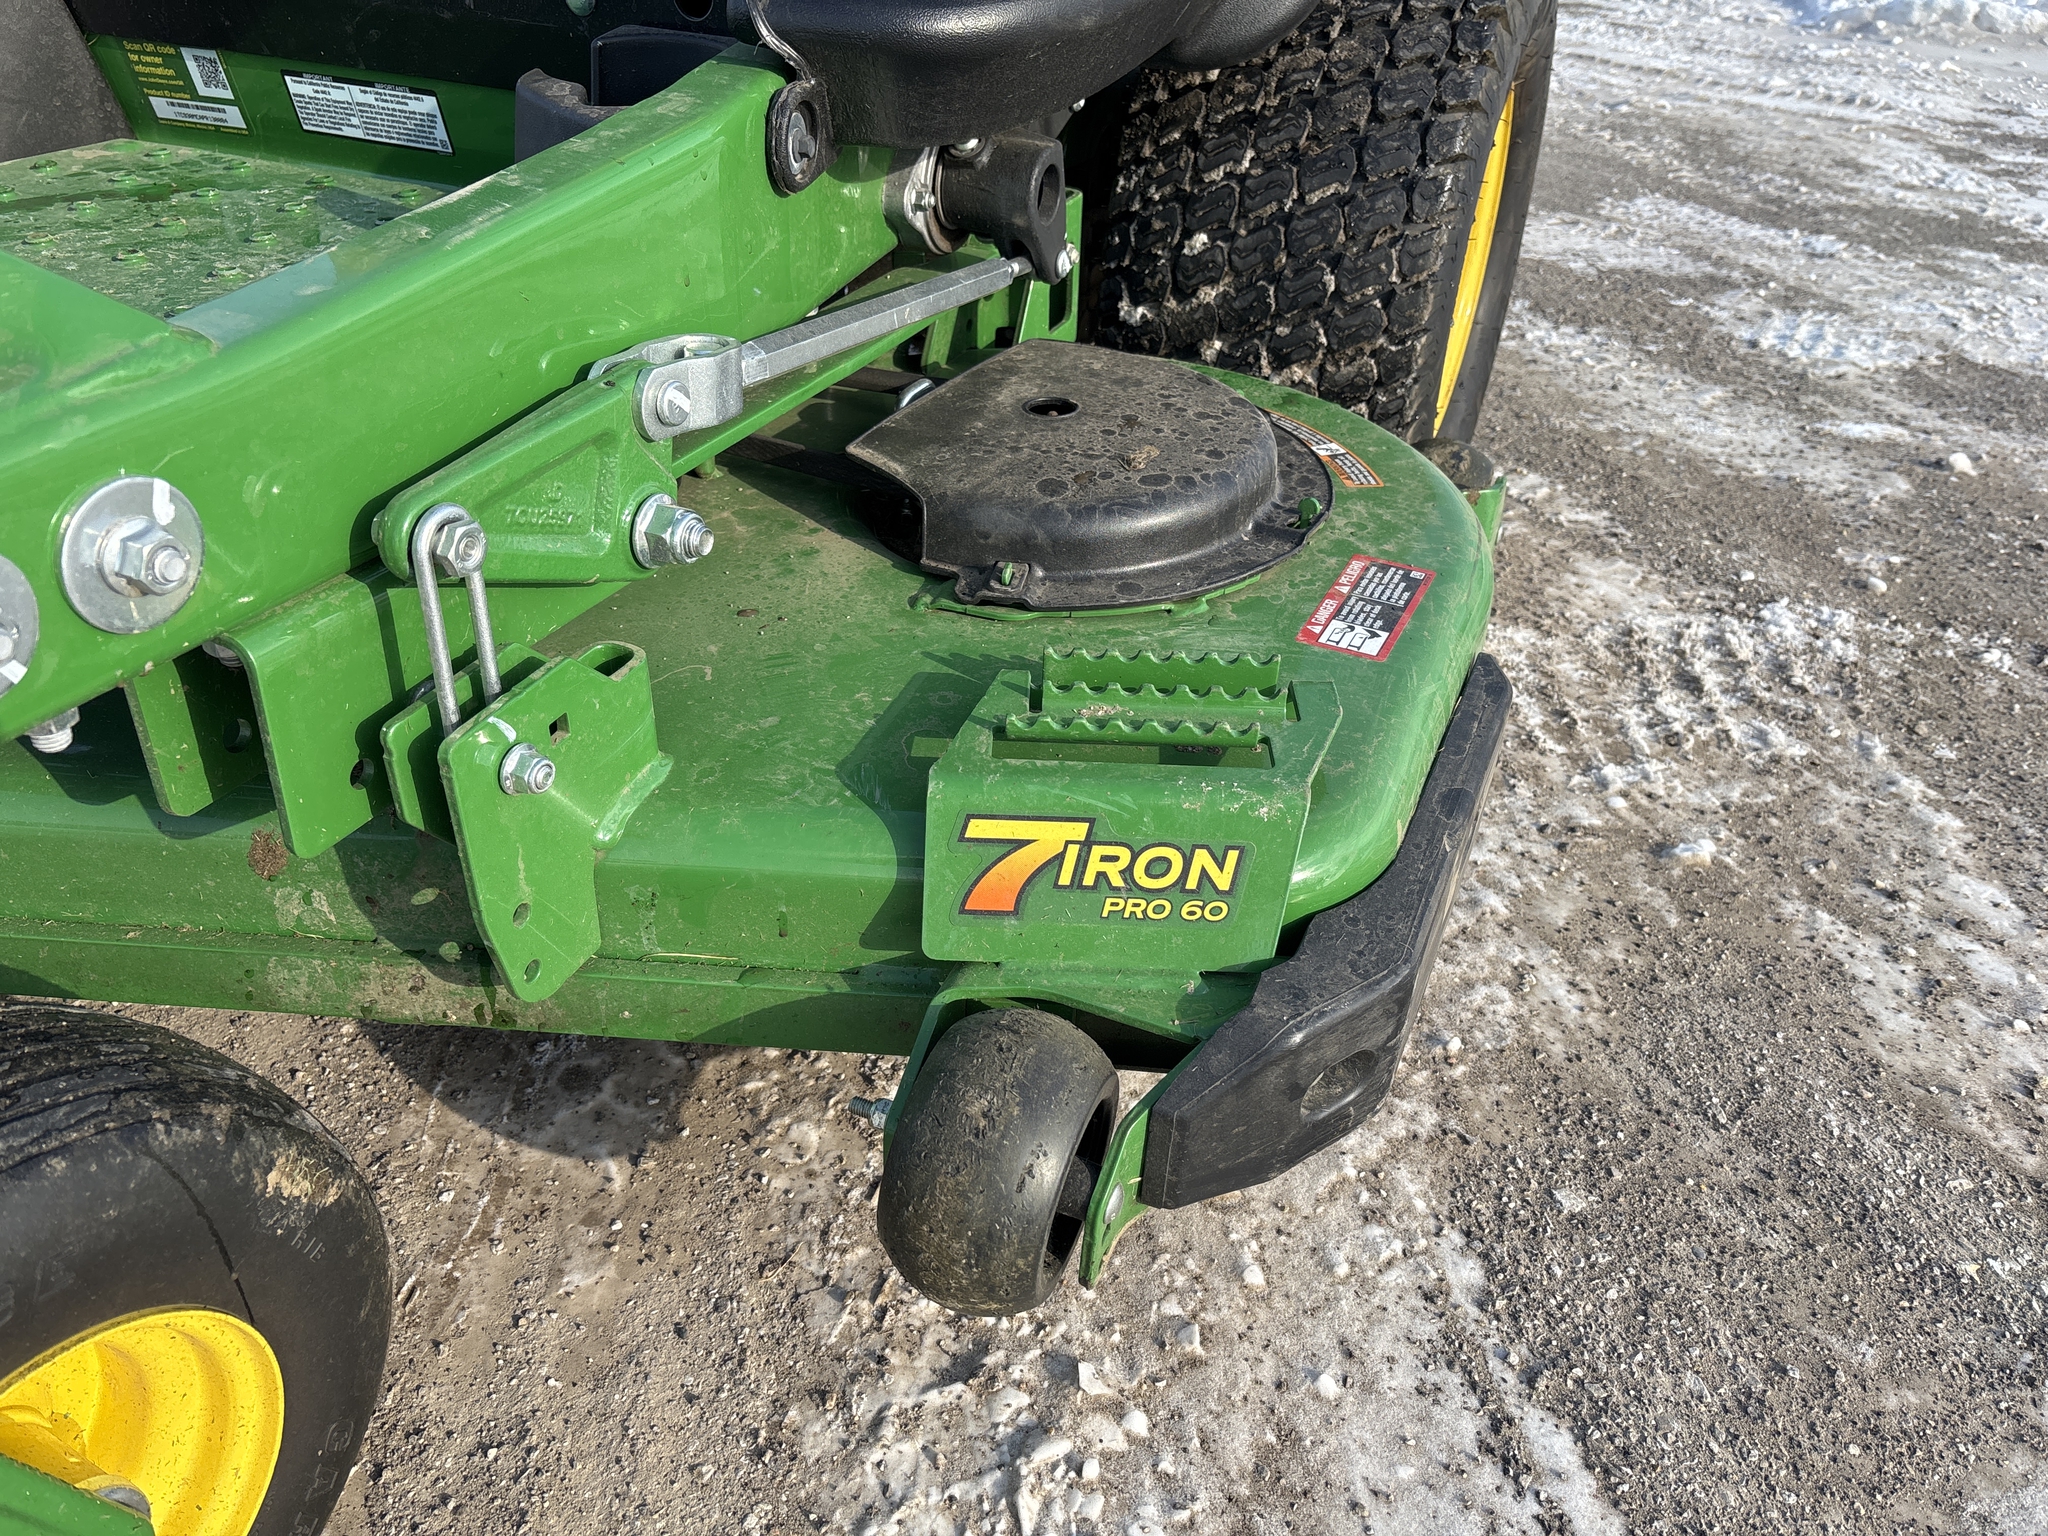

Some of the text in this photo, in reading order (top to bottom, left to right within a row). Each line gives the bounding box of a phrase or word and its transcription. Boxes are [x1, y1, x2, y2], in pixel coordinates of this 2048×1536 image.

[121, 40, 176, 55] Scan QR code
[127, 52, 164, 64] for owner
[131, 63, 176, 77] information
[302, 73, 333, 82] IMPORTANT
[142, 87, 163, 96] Product
[170, 91, 192, 99] number
[374, 83, 410, 93] IMPORTANTE
[1337, 559, 1365, 585] PELIGRO
[1311, 598, 1339, 624] DANGER
[1101, 896, 1230, 922] PRO 60
